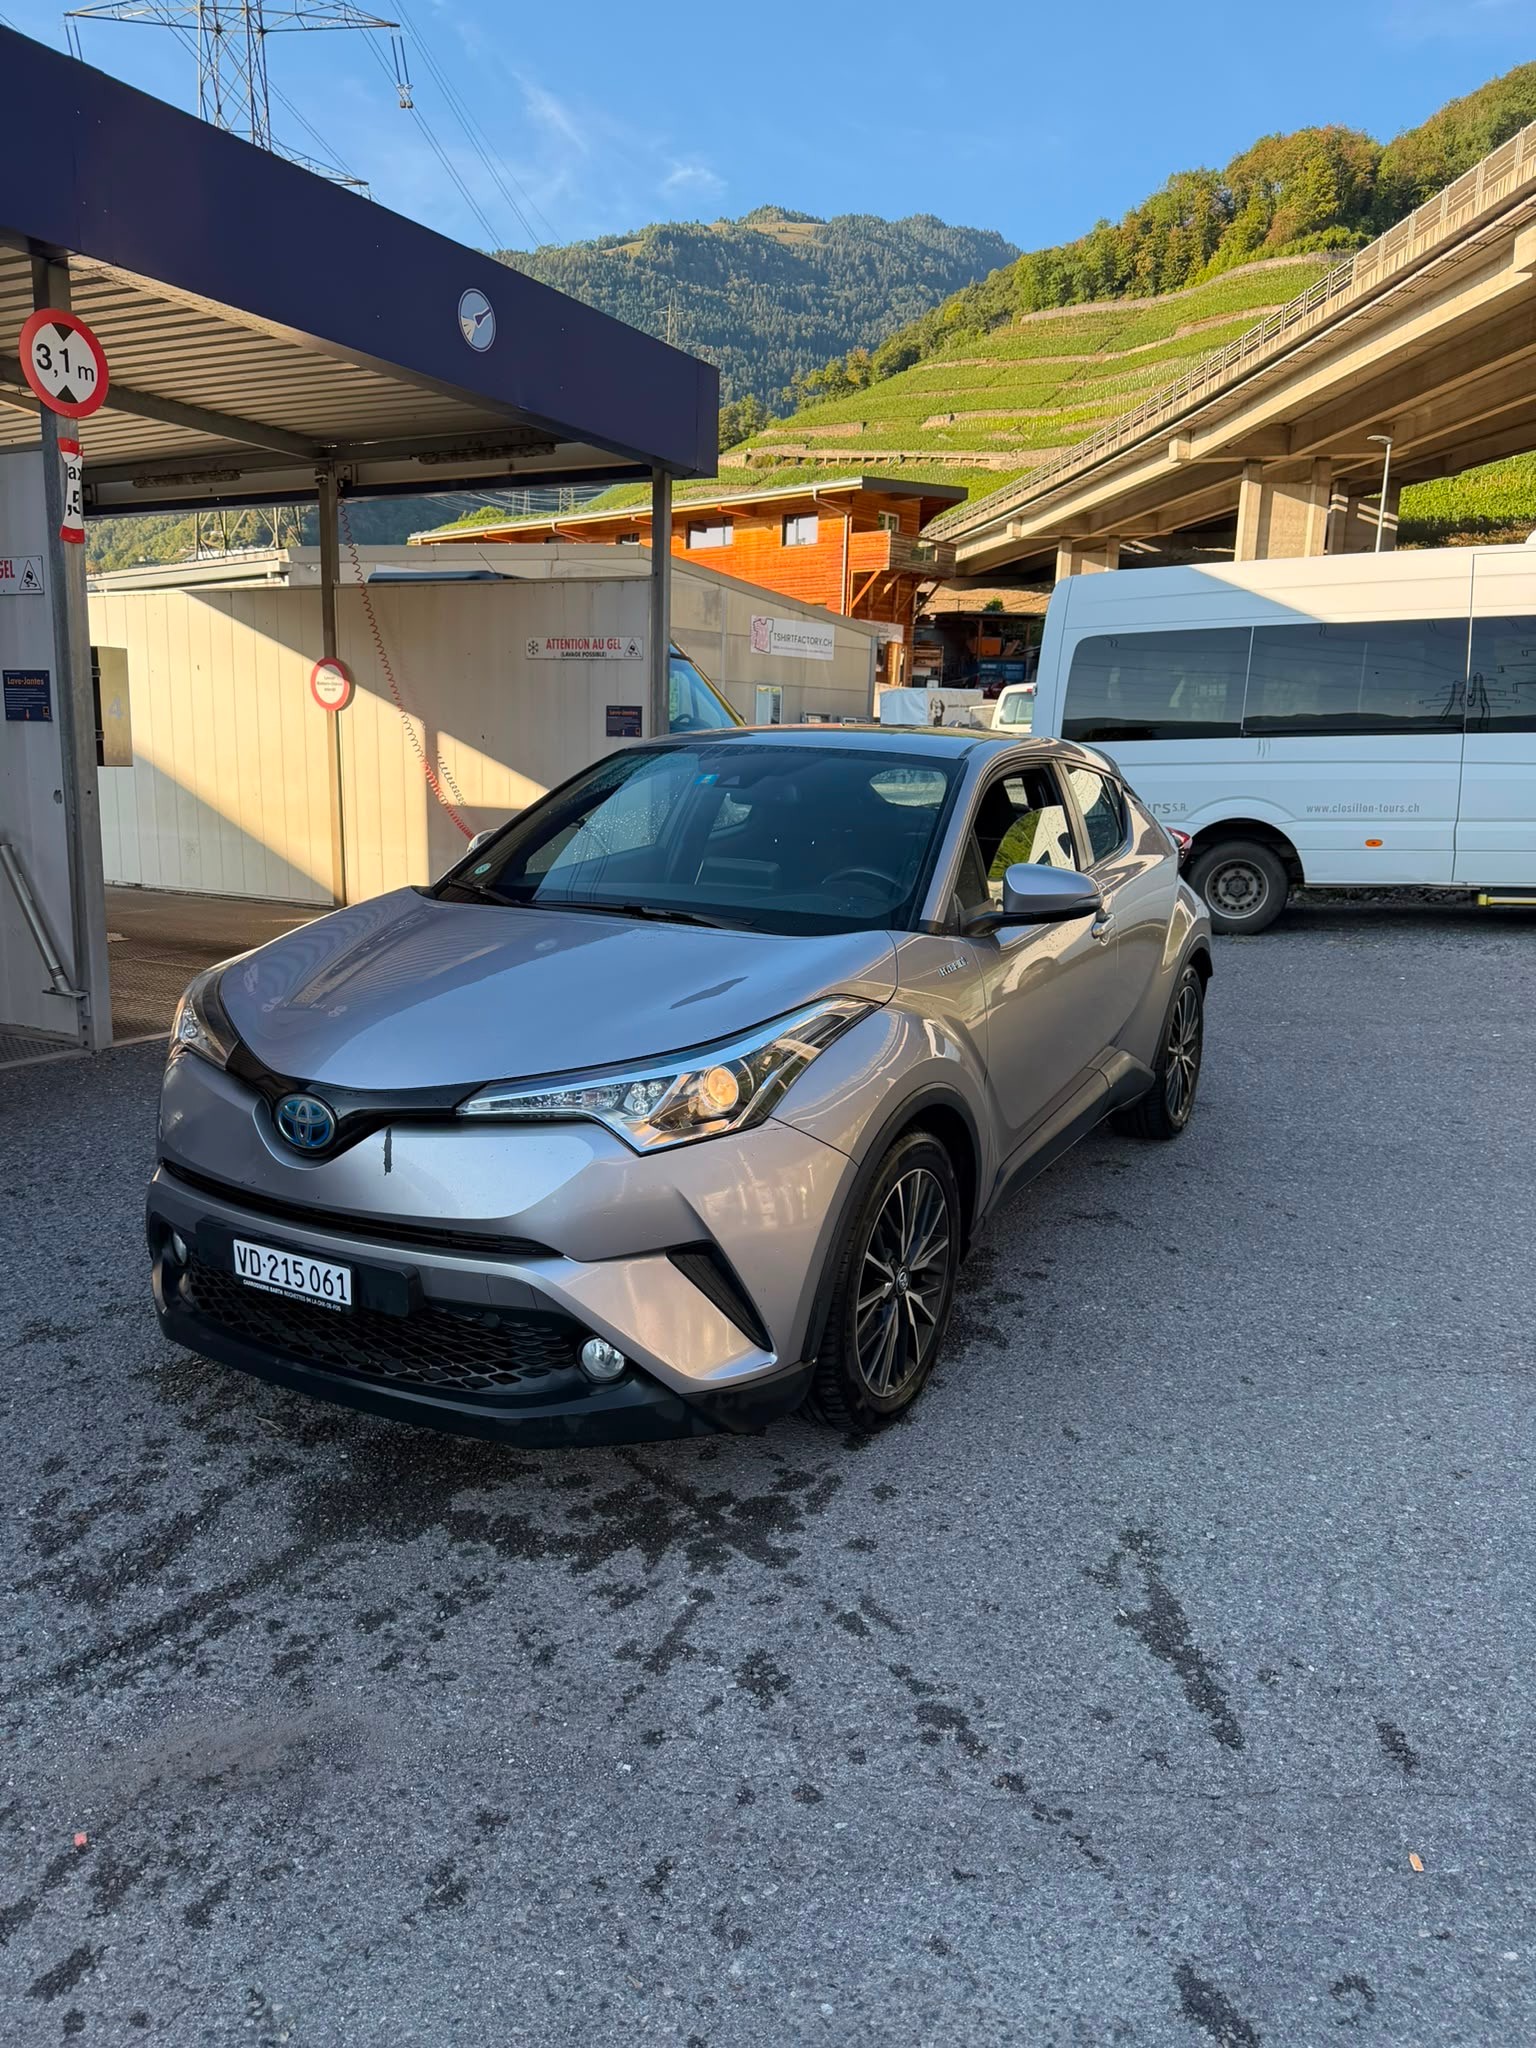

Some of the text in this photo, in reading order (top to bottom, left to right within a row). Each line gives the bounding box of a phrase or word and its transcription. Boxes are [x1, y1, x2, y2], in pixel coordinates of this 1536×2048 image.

[36, 343, 95, 382] 3,1 m
[546, 638, 622, 650] ATTENTION AU GEL
